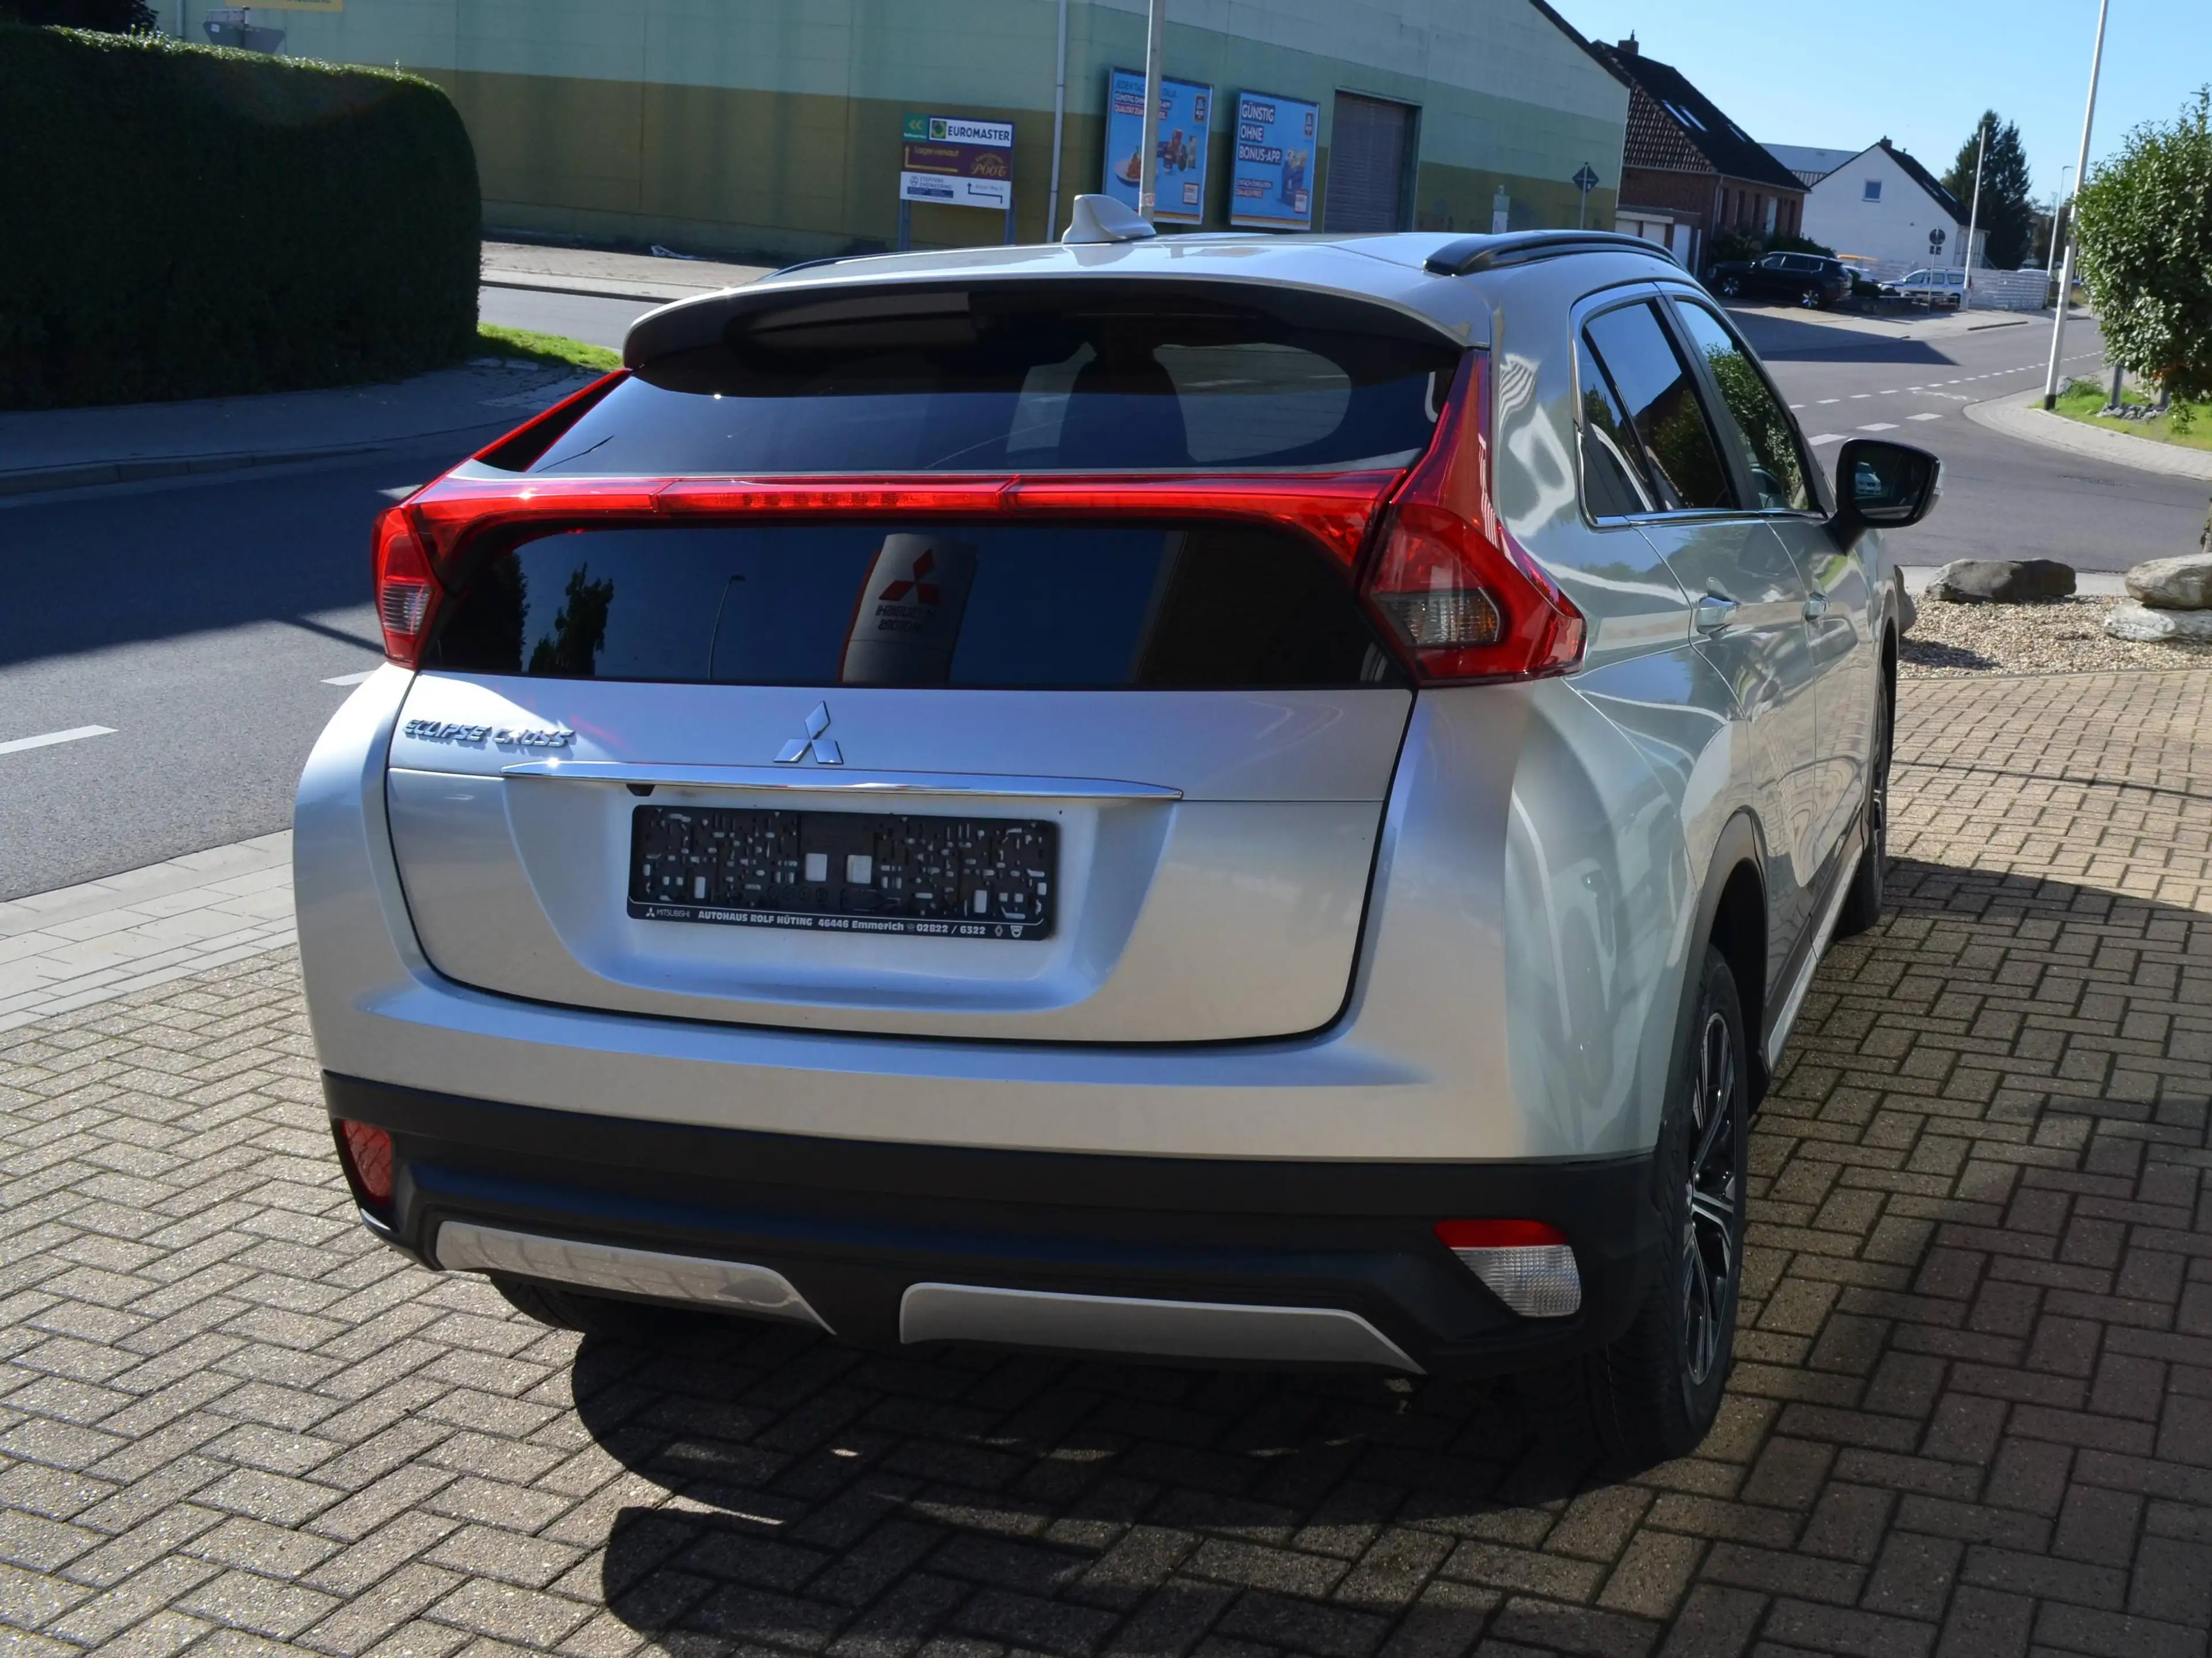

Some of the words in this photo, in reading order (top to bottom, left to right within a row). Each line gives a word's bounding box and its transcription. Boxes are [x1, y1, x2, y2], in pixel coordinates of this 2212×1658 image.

[1242, 102, 1274, 122] GÜNSTIG
[948, 125, 1010, 141] EUROMASTER
[1240, 125, 1263, 141] OHNE
[403, 719, 491, 742] ECLIPSE
[656, 908, 690, 917] MITSUBISHI
[698, 910, 747, 922] AUTOHAUS
[751, 914, 774, 924] ROLF
[777, 915, 812, 926] HÜTING
[818, 919, 849, 928] 46446
[852, 920, 904, 931] Emmerich
[916, 923, 948, 933] 02822
[960, 925, 986, 935] 6322
